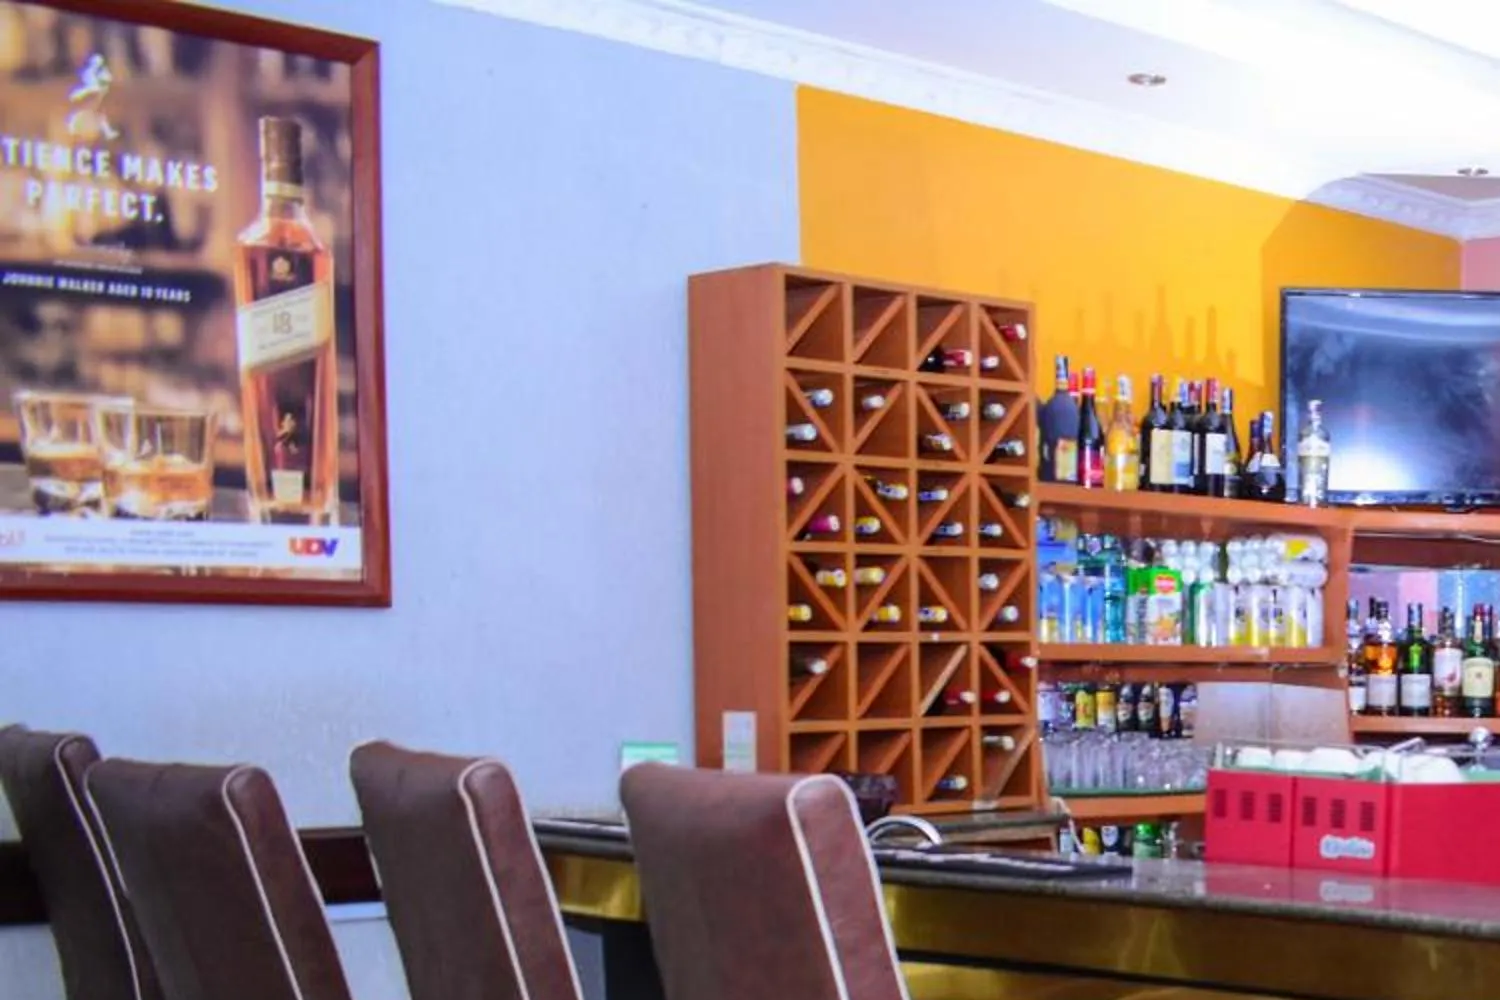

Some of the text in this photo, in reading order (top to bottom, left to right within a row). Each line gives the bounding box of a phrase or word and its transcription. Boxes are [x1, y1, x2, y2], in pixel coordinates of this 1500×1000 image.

[121, 153, 218, 192] MAKES
[57, 275, 104, 293] WALKER
[289, 537, 338, 556] UDV
